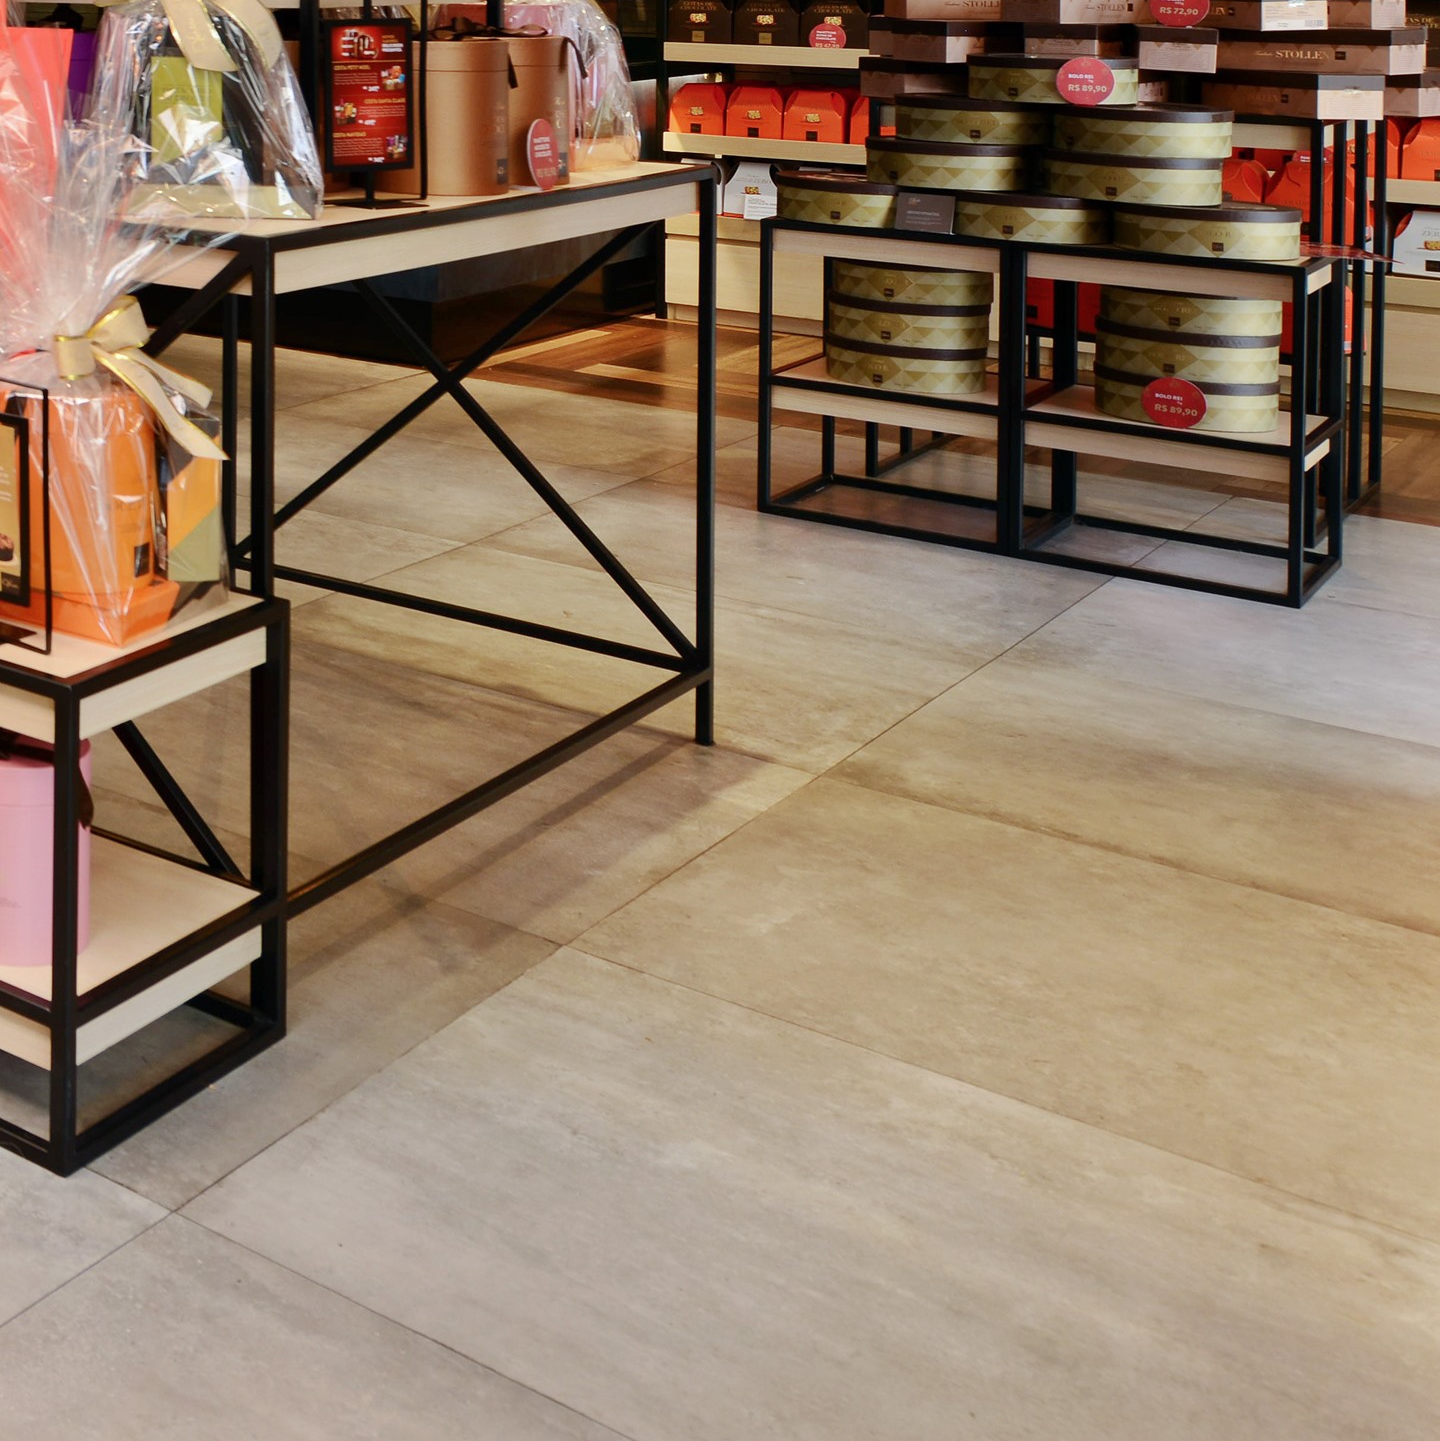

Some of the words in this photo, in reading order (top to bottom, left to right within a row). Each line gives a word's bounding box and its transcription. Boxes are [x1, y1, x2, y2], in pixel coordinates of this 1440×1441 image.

[1159, 6, 1172, 15] R$
[1173, 7, 1199, 16] 72,90
[1275, 49, 1329, 60] STOLLEN
[1068, 83, 1080, 92] R$
[1082, 84, 1107, 93] 89,90
[1155, 392, 1172, 400] BOLO
[1154, 403, 1167, 413] R$
[1169, 405, 1198, 416] 89,90
